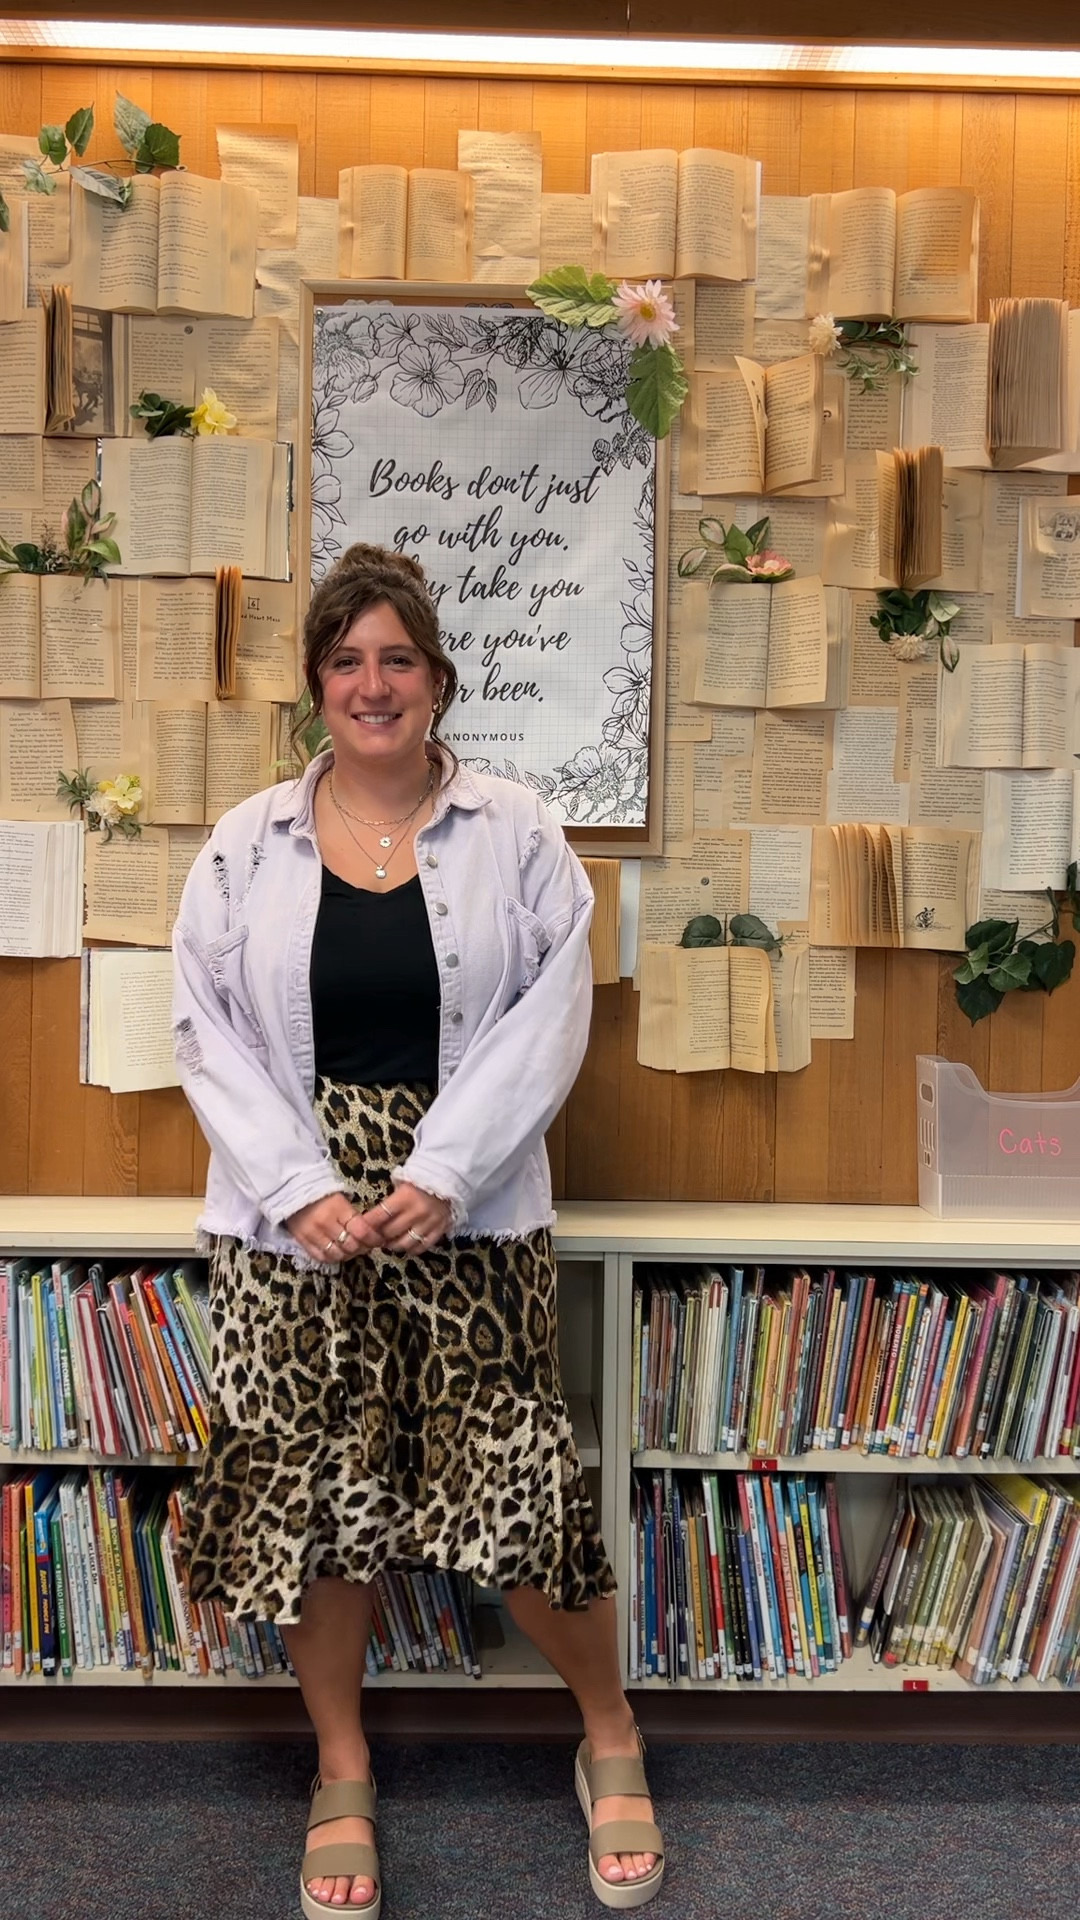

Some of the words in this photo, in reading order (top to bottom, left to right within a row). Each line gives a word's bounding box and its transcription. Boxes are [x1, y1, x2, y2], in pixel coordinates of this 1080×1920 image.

[369, 458, 459, 500] Books
[467, 464, 539, 502] don't
[535, 466, 601, 513] just
[394, 524, 430, 553] go
[438, 505, 502, 552] with
[508, 528, 568, 565] you.
[457, 565, 522, 603] take
[528, 579, 584, 617] you
[438, 630, 475, 651] ere
[482, 624, 571, 667] you've
[483, 662, 544, 702] been.
[444, 733, 525, 742] ANONYMOUS
[999, 1127, 1062, 1156] Cats
[890, 1323, 902, 1358] ROBERTO
[60, 1355, 71, 1397] PROMISE
[185, 1353, 197, 1374] Moved
[761, 1461, 768, 1469] K
[88, 1552, 96, 1571] LUCKY
[55, 1569, 63, 1597] BUFFALO
[57, 1597, 66, 1628] FLUFFALO
[912, 1681, 918, 1690] L
